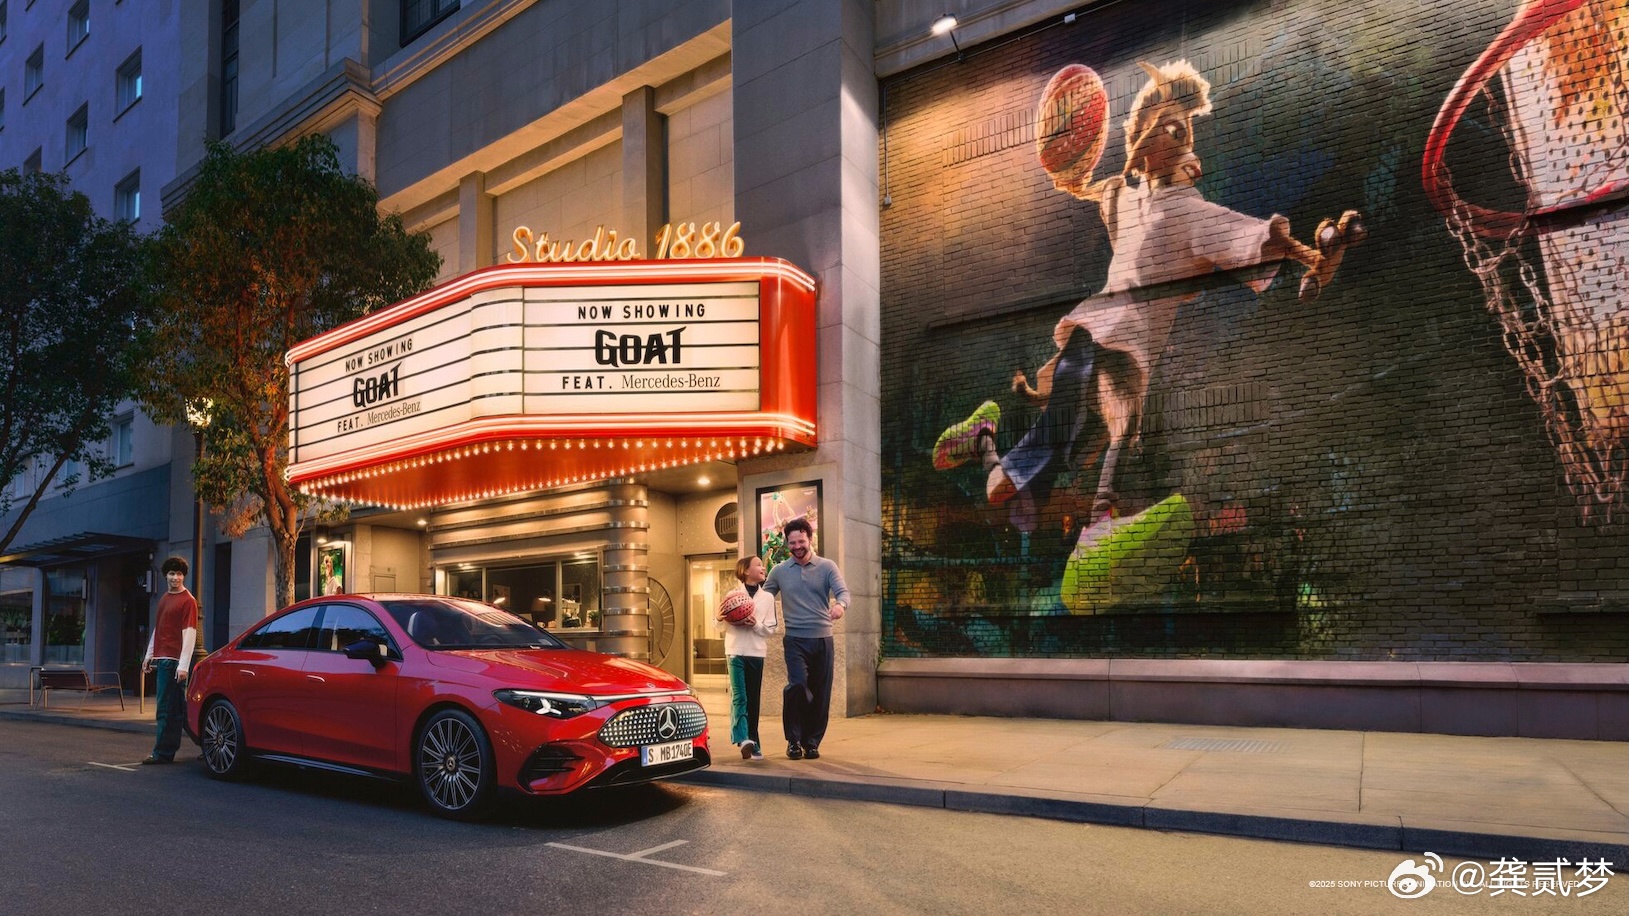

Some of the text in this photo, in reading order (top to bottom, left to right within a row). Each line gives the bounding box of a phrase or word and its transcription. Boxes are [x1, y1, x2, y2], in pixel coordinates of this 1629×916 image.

[506, 221, 745, 263] Studio 1886
[577, 303, 706, 320] NOW SHOWING
[345, 338, 413, 373] NOW SHOWING
[594, 326, 687, 368] GOAT
[353, 361, 403, 408] GOAT
[562, 373, 721, 390] FEAT. Mercedes-Benz
[337, 401, 421, 433] FEAT. Mercedes-Benz
[648, 748, 654, 763] S
